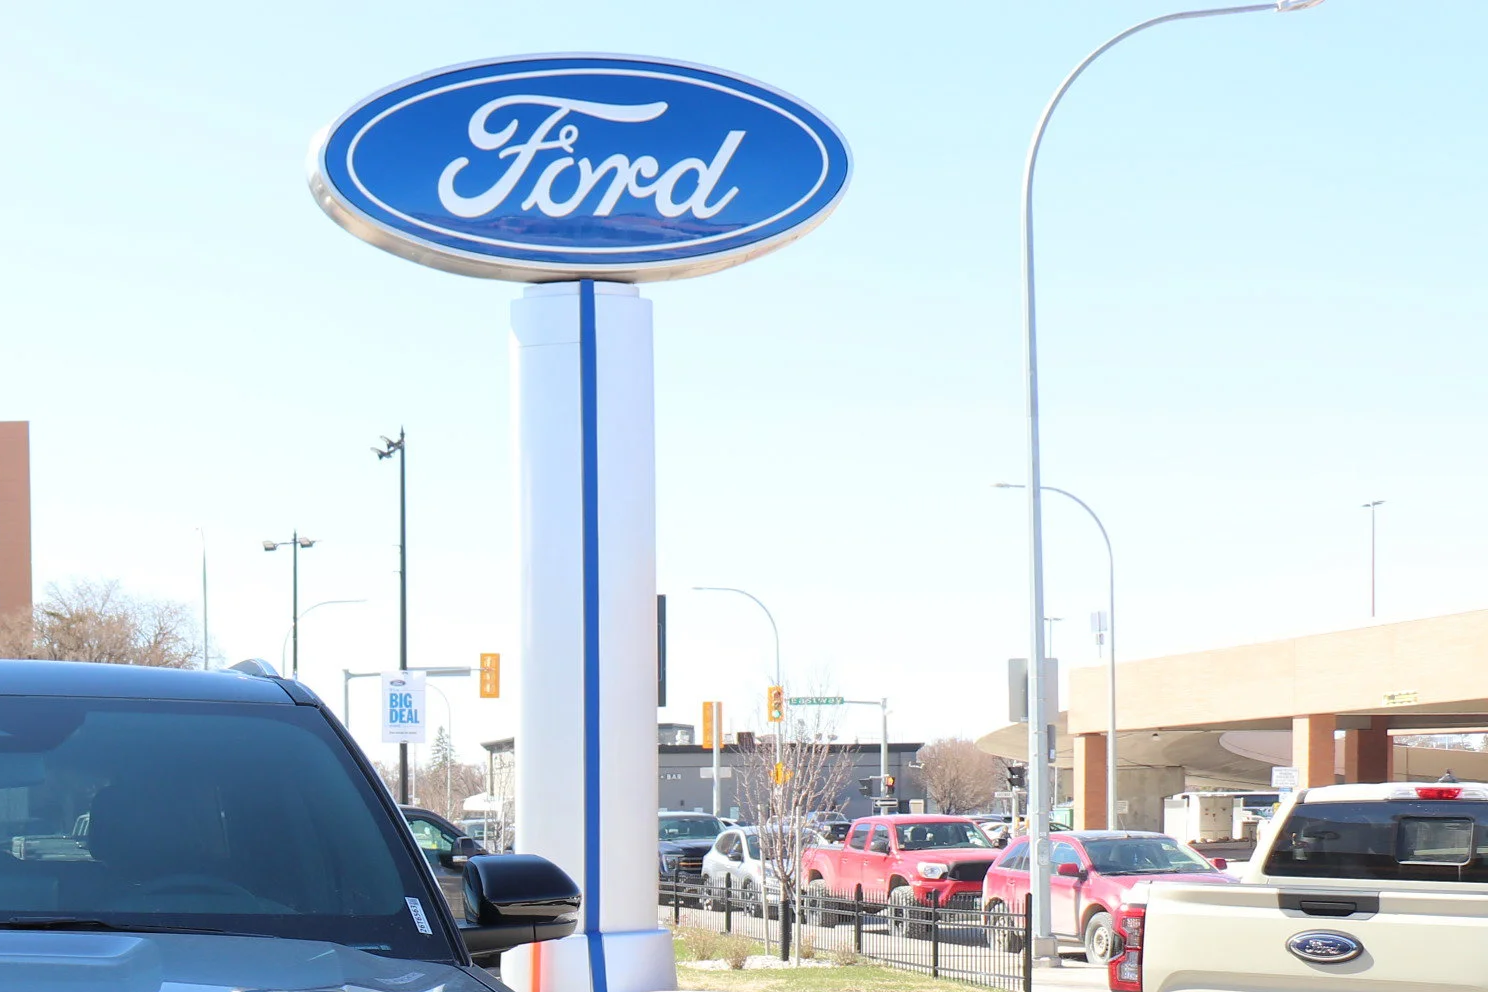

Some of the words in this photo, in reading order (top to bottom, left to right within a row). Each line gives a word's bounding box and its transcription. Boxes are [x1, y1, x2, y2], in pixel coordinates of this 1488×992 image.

[438, 94, 746, 219] Ford
[389, 692, 413, 708] BIG
[389, 708, 420, 724] DEAL
[1304, 937, 1341, 955] Ford
